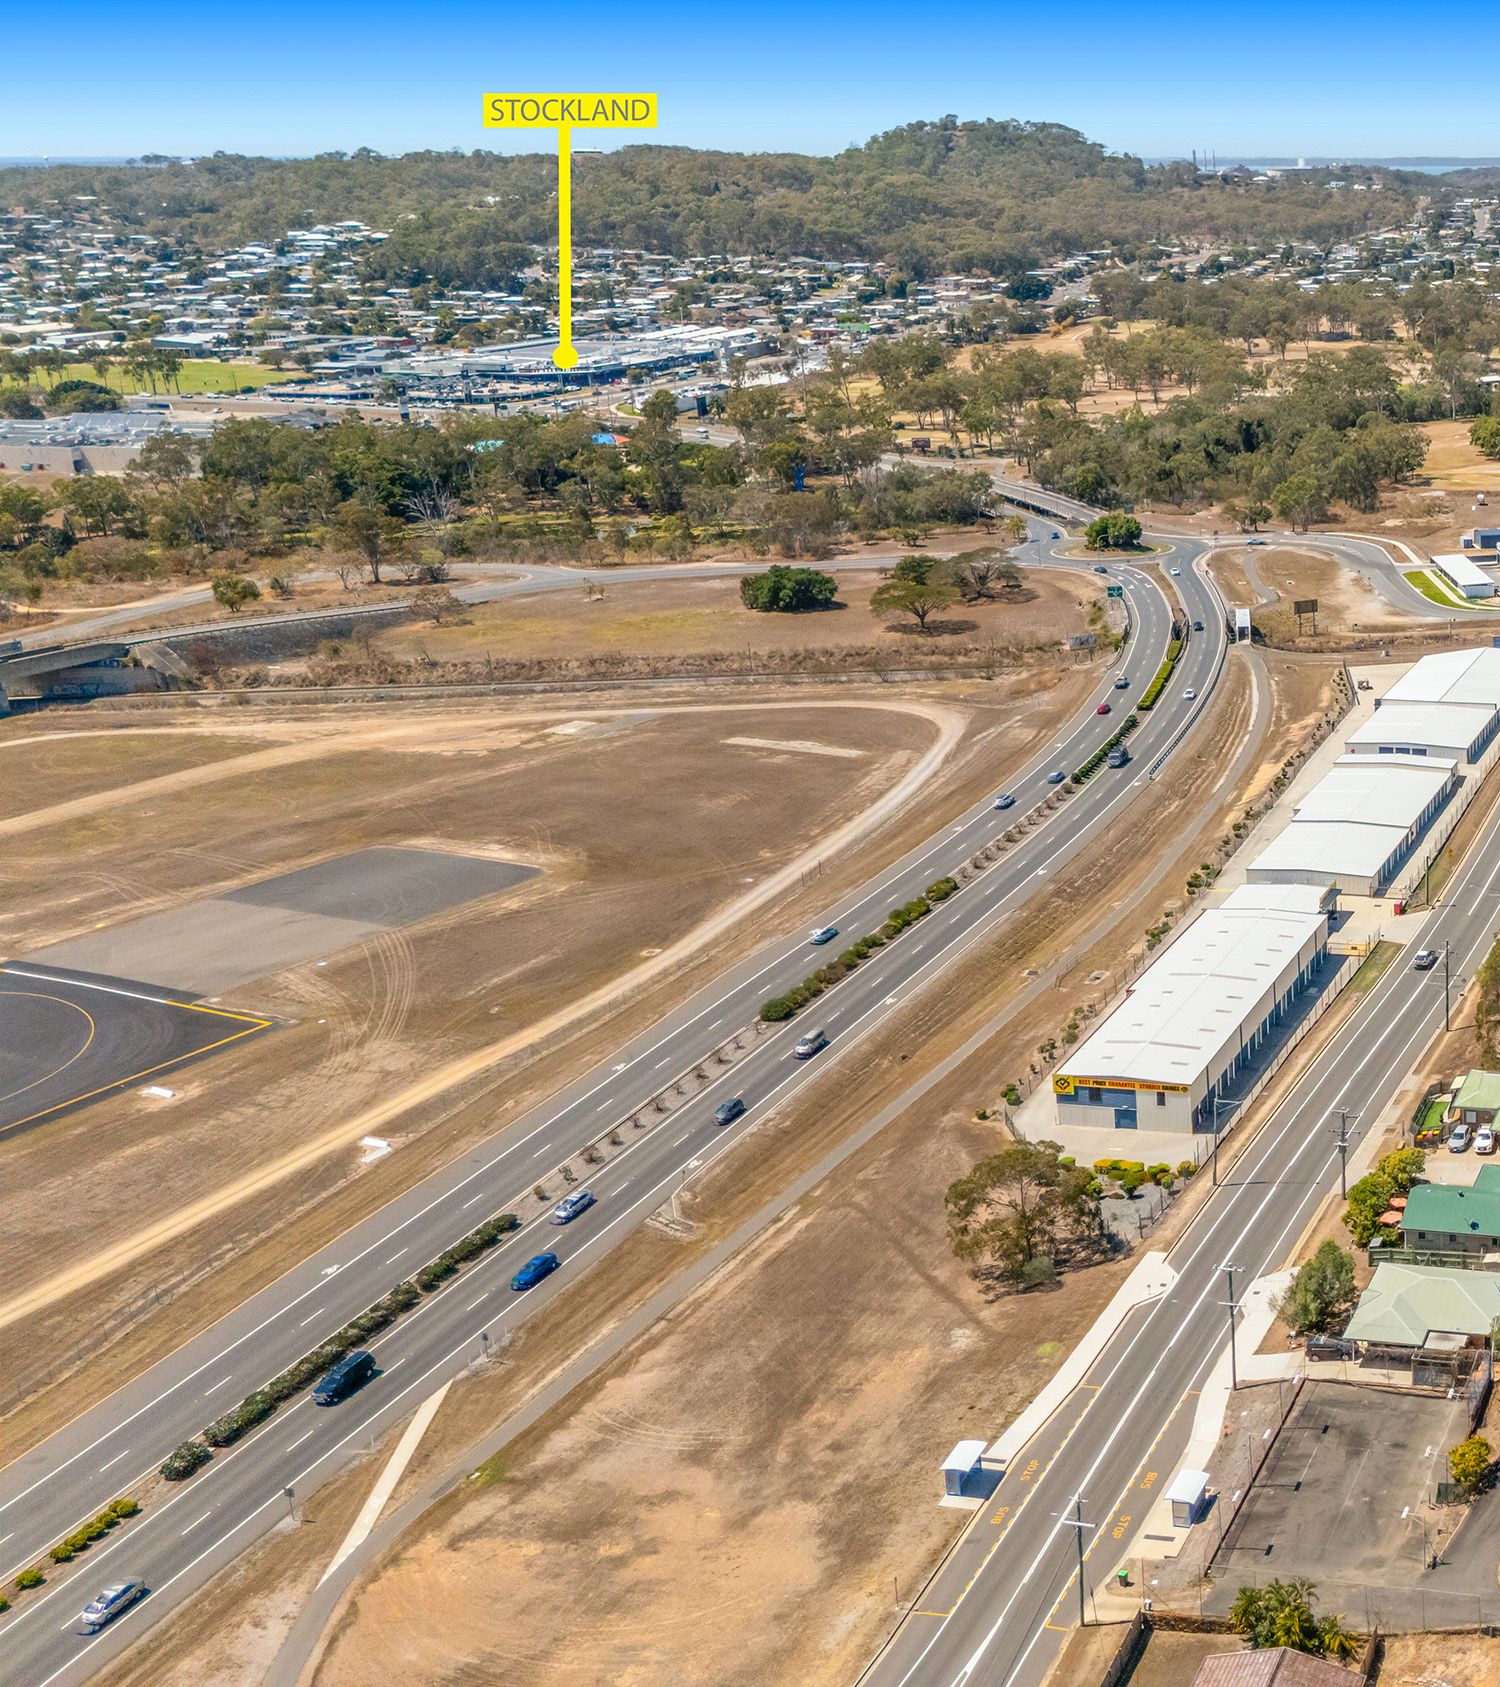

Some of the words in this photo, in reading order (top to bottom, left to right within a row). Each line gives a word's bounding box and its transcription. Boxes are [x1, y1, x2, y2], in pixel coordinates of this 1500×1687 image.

[990, 1505, 1009, 1525] BUS
[1020, 1459, 1040, 1481] STOP
[1140, 1471, 1158, 1489] BUS
[1111, 1514, 1132, 1539] STOP
